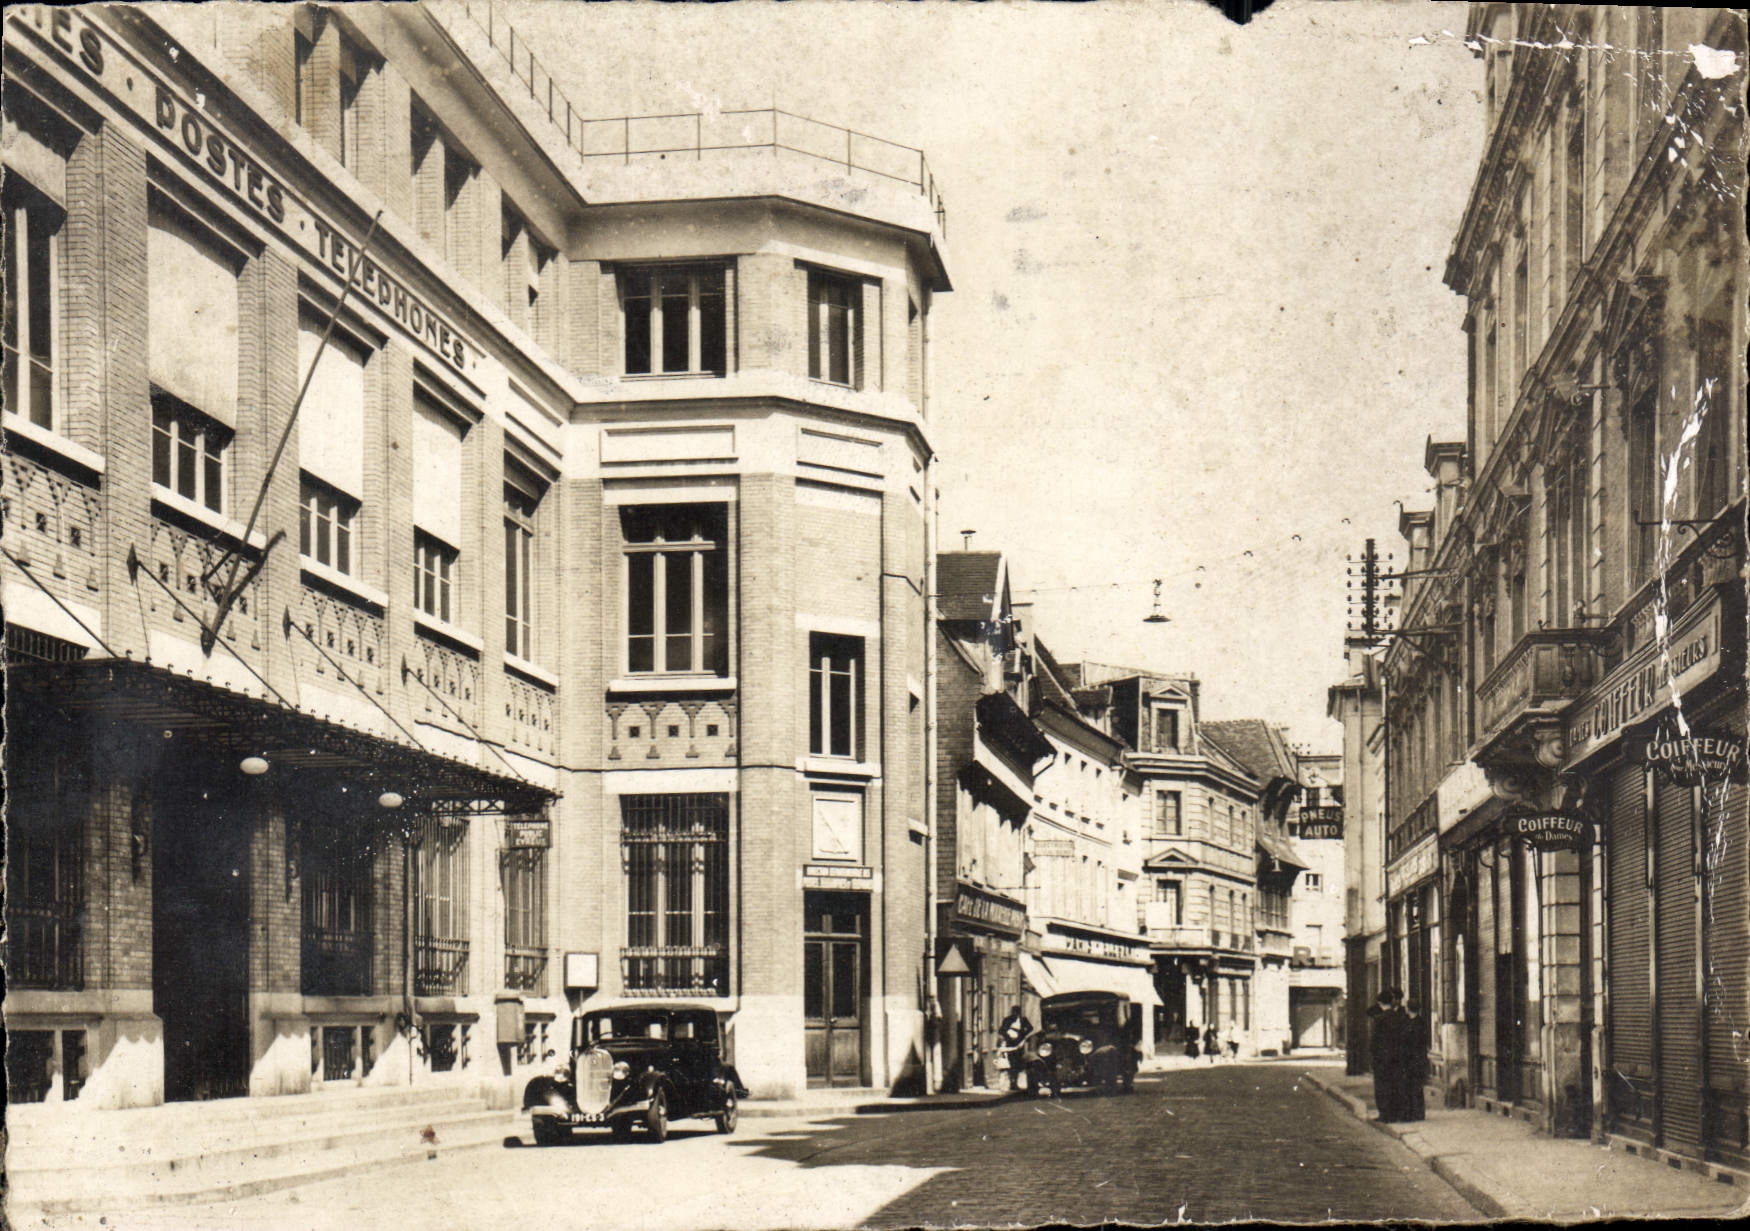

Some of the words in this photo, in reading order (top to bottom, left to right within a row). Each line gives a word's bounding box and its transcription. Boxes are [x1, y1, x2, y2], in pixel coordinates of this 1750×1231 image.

[155, 85, 285, 224] POSTES
[315, 220, 465, 370] TELEPHONES
[1593, 664, 1656, 741] COIFFEUR
[1646, 737, 1741, 763] COIFFEUR
[1300, 808, 1343, 824] PNEUS
[1517, 816, 1584, 835] COIFFEUR
[1304, 824, 1338, 838] AUTO
